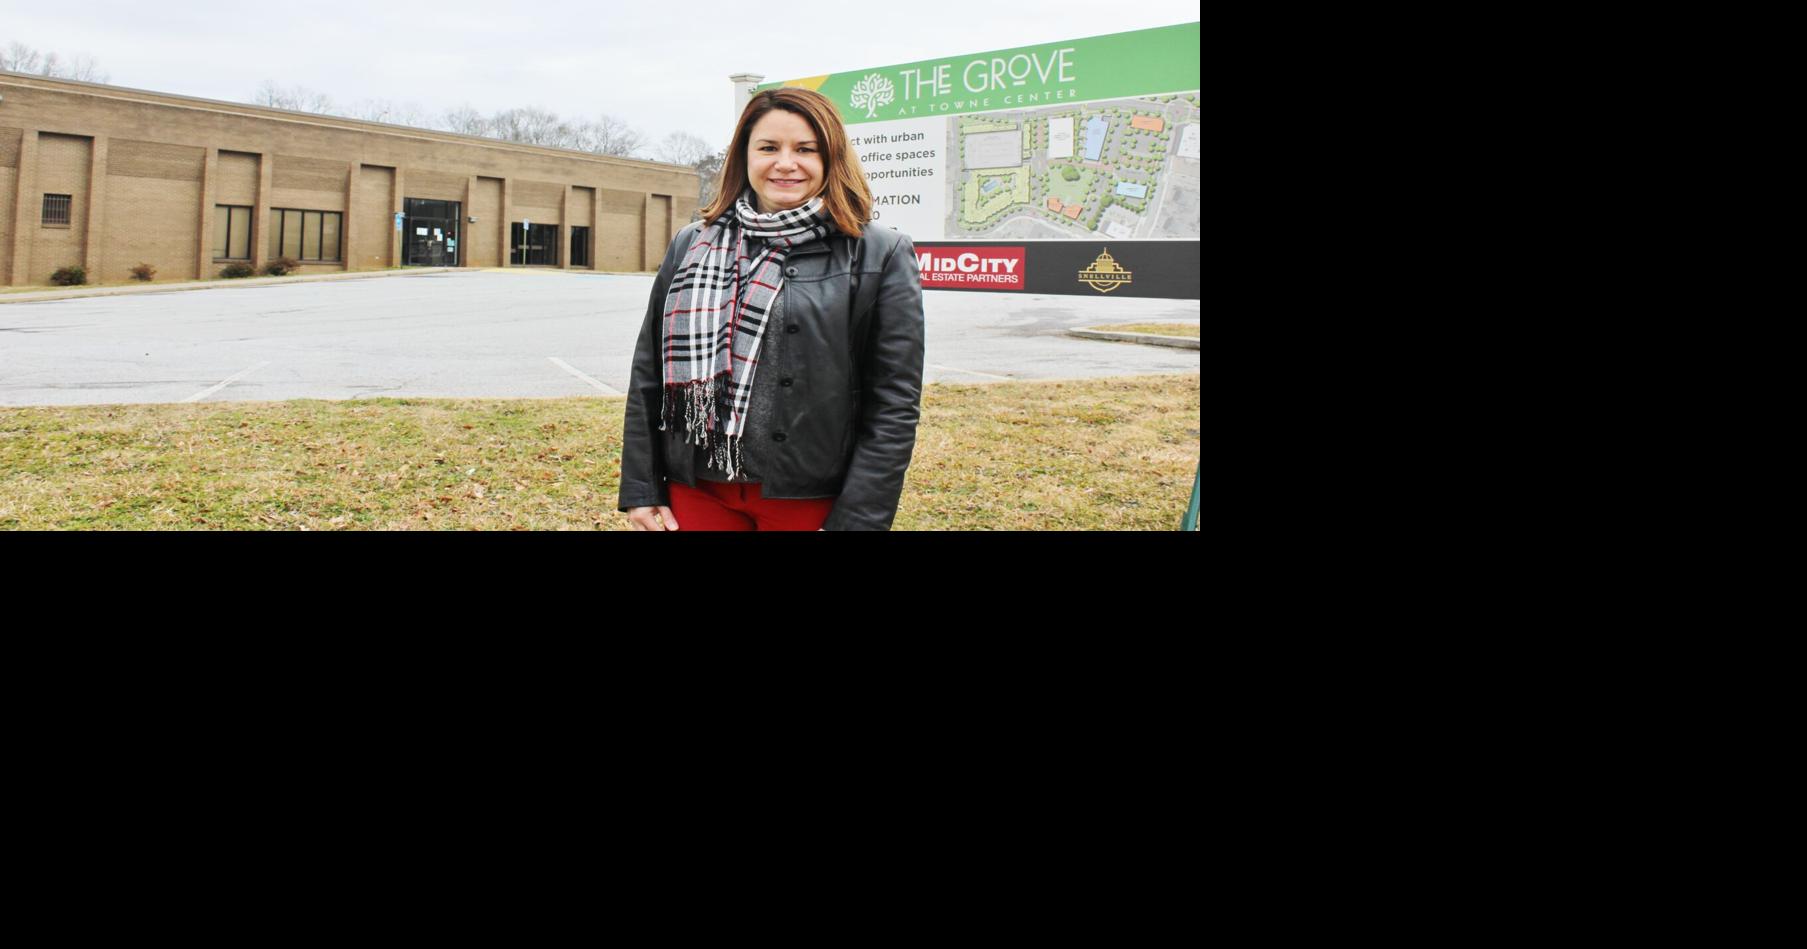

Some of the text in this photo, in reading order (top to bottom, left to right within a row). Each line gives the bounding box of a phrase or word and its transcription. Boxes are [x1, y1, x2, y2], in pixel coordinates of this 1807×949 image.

[899, 48, 1076, 100] THE GROVE
[899, 89, 1076, 115] AT TOWNE CENTER
[863, 134, 887, 145] with
[891, 132, 924, 143] urban
[861, 150, 936, 163] office spaces
[931, 273, 965, 282] ESTATE
[966, 273, 1019, 284] PARTNERS
